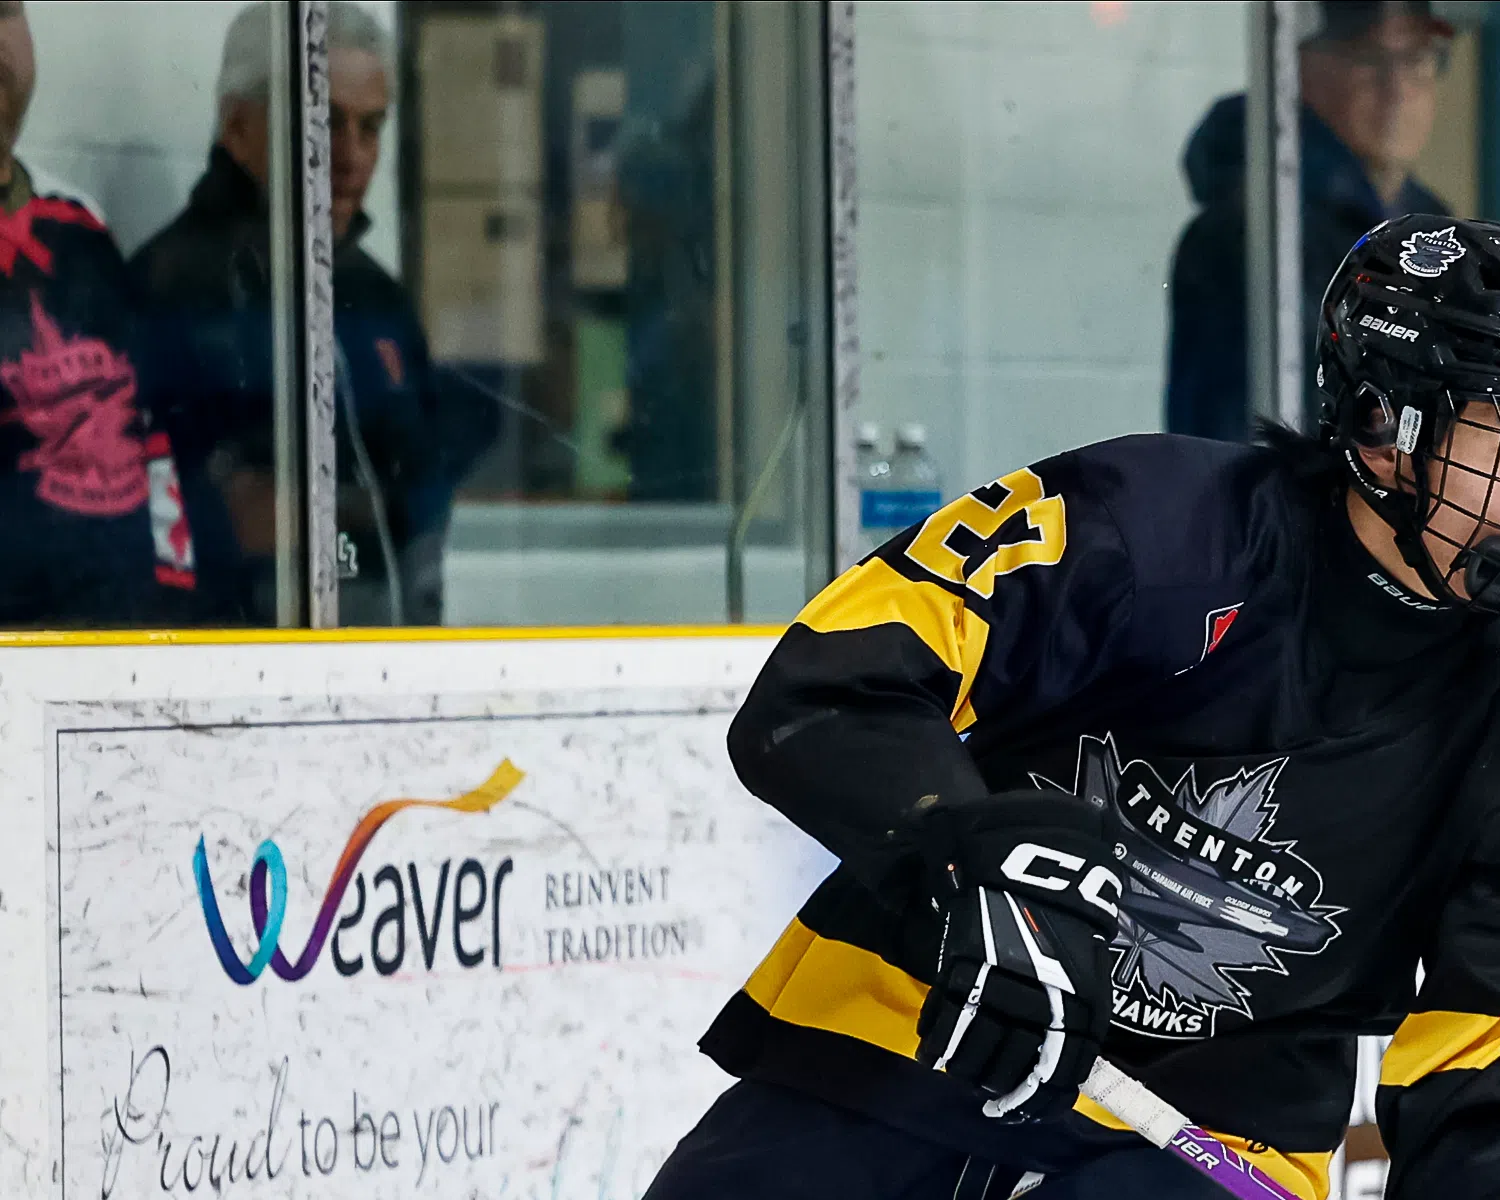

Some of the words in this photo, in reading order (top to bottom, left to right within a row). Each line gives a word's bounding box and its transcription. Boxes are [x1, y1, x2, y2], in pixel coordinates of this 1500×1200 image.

[1358, 314, 1420, 344] BAUER
[1366, 572, 1453, 612] BAUE
[192, 758, 527, 986] Weaver
[544, 865, 671, 909] REINVENT
[1126, 783, 1305, 900] TRENTON
[1000, 842, 1123, 919] CC
[545, 920, 689, 967] TRADITION
[1111, 988, 1204, 1034] HAWKS
[300, 1107, 337, 1173] to
[353, 1090, 400, 1170] be
[413, 1100, 500, 1189] your
